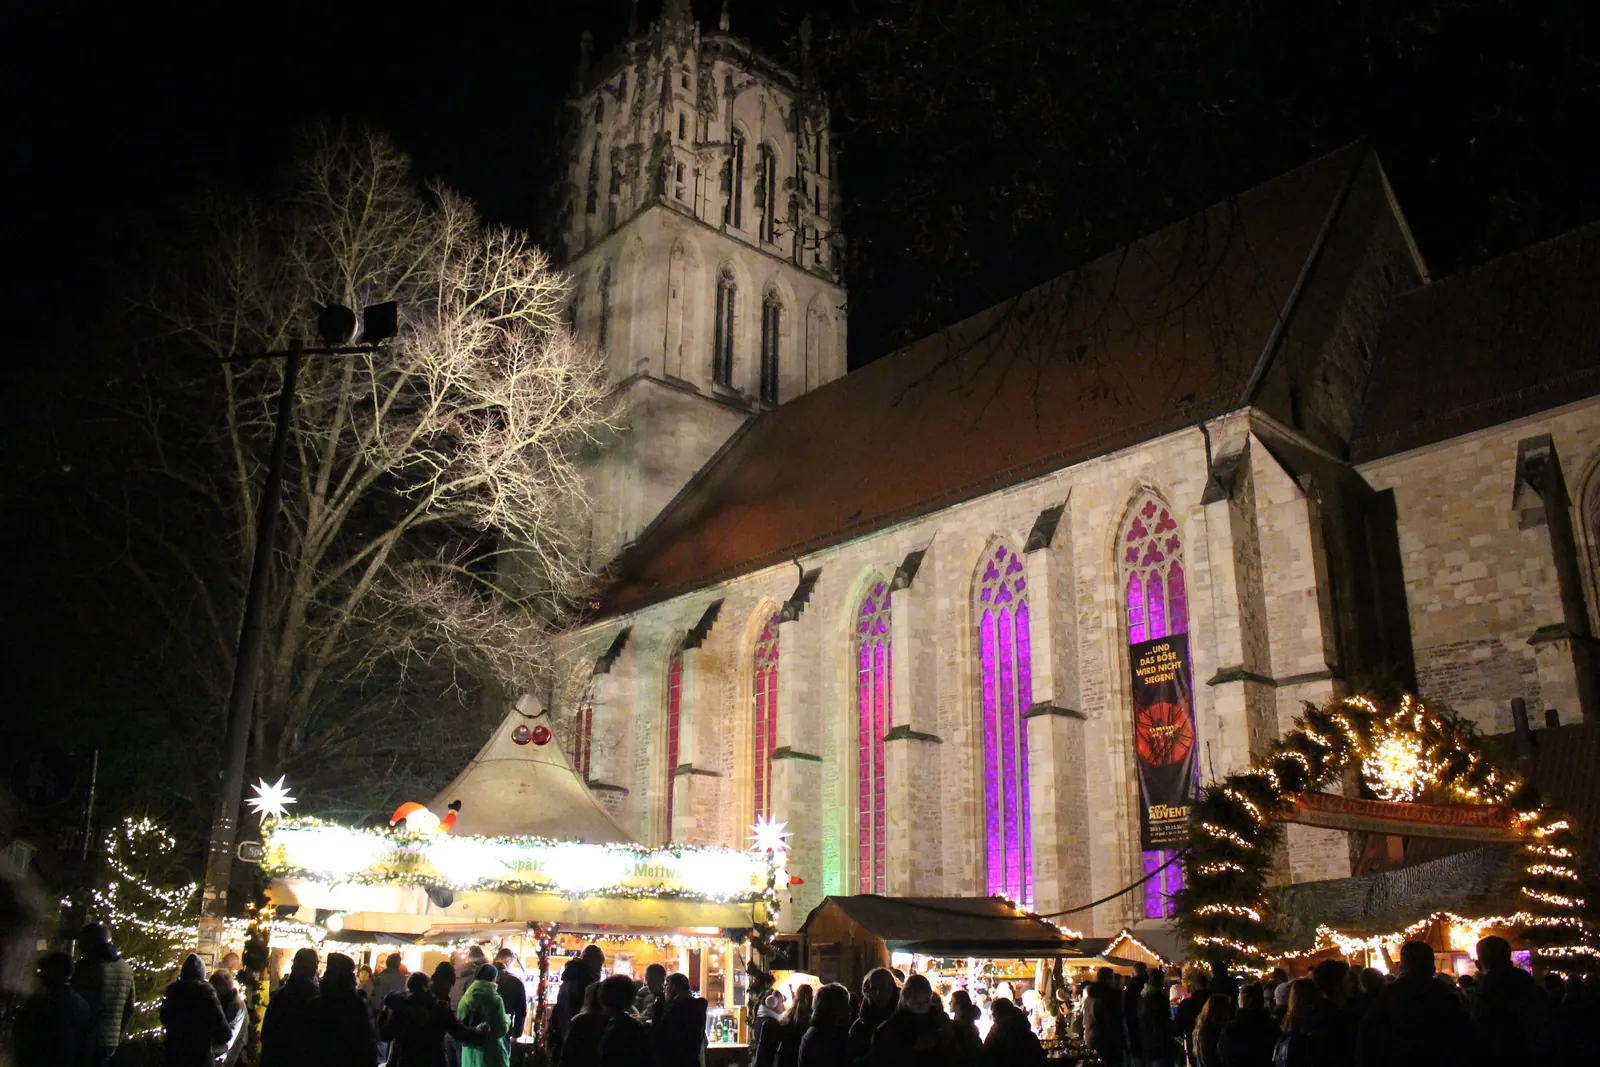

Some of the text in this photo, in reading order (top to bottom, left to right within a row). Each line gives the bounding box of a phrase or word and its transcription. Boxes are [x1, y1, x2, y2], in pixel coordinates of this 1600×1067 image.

[1140, 651, 1177, 666] DAS BÖSE
[1136, 661, 1182, 676] WIRD NICHT
[1148, 806, 1188, 819] ADVENT
